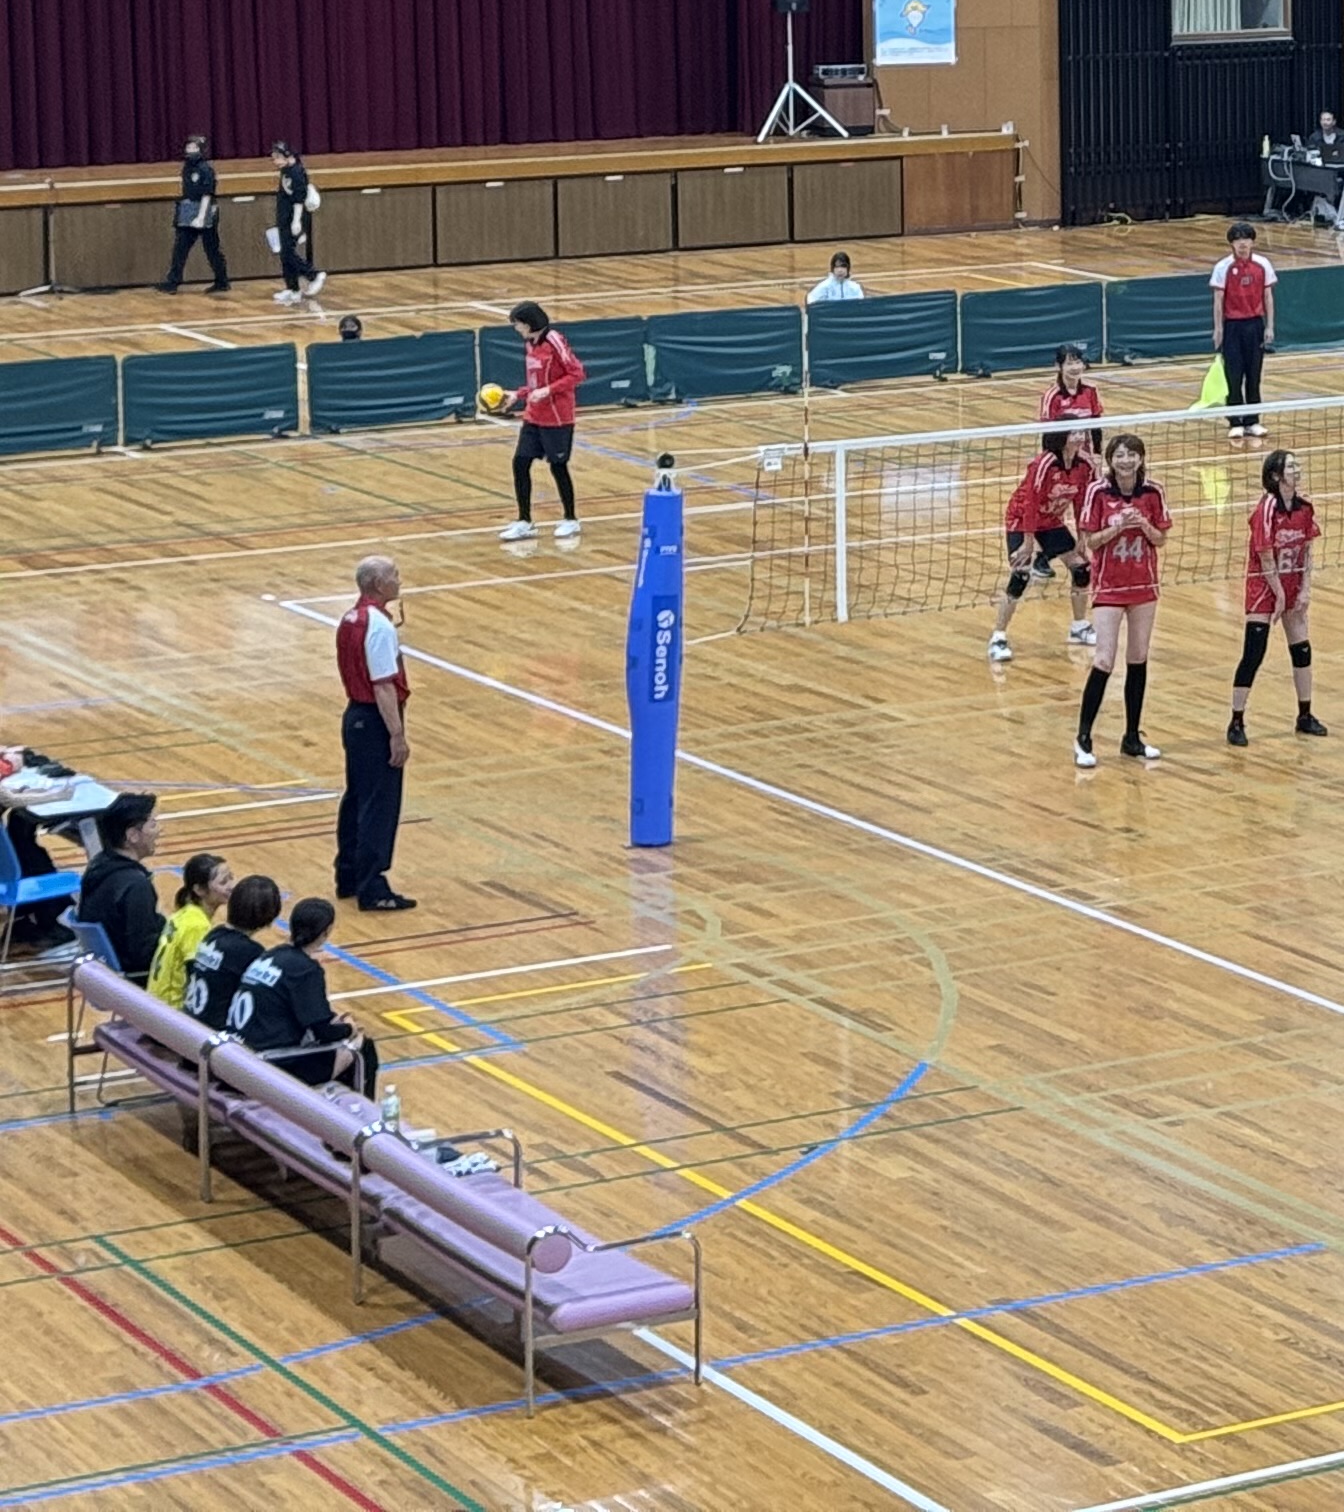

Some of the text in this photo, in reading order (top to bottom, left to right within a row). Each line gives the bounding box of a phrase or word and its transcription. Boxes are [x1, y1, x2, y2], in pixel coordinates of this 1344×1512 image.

[1113, 535, 1144, 564] 44
[653, 629, 672, 700] Senoh
[226, 989, 254, 1030] 10
